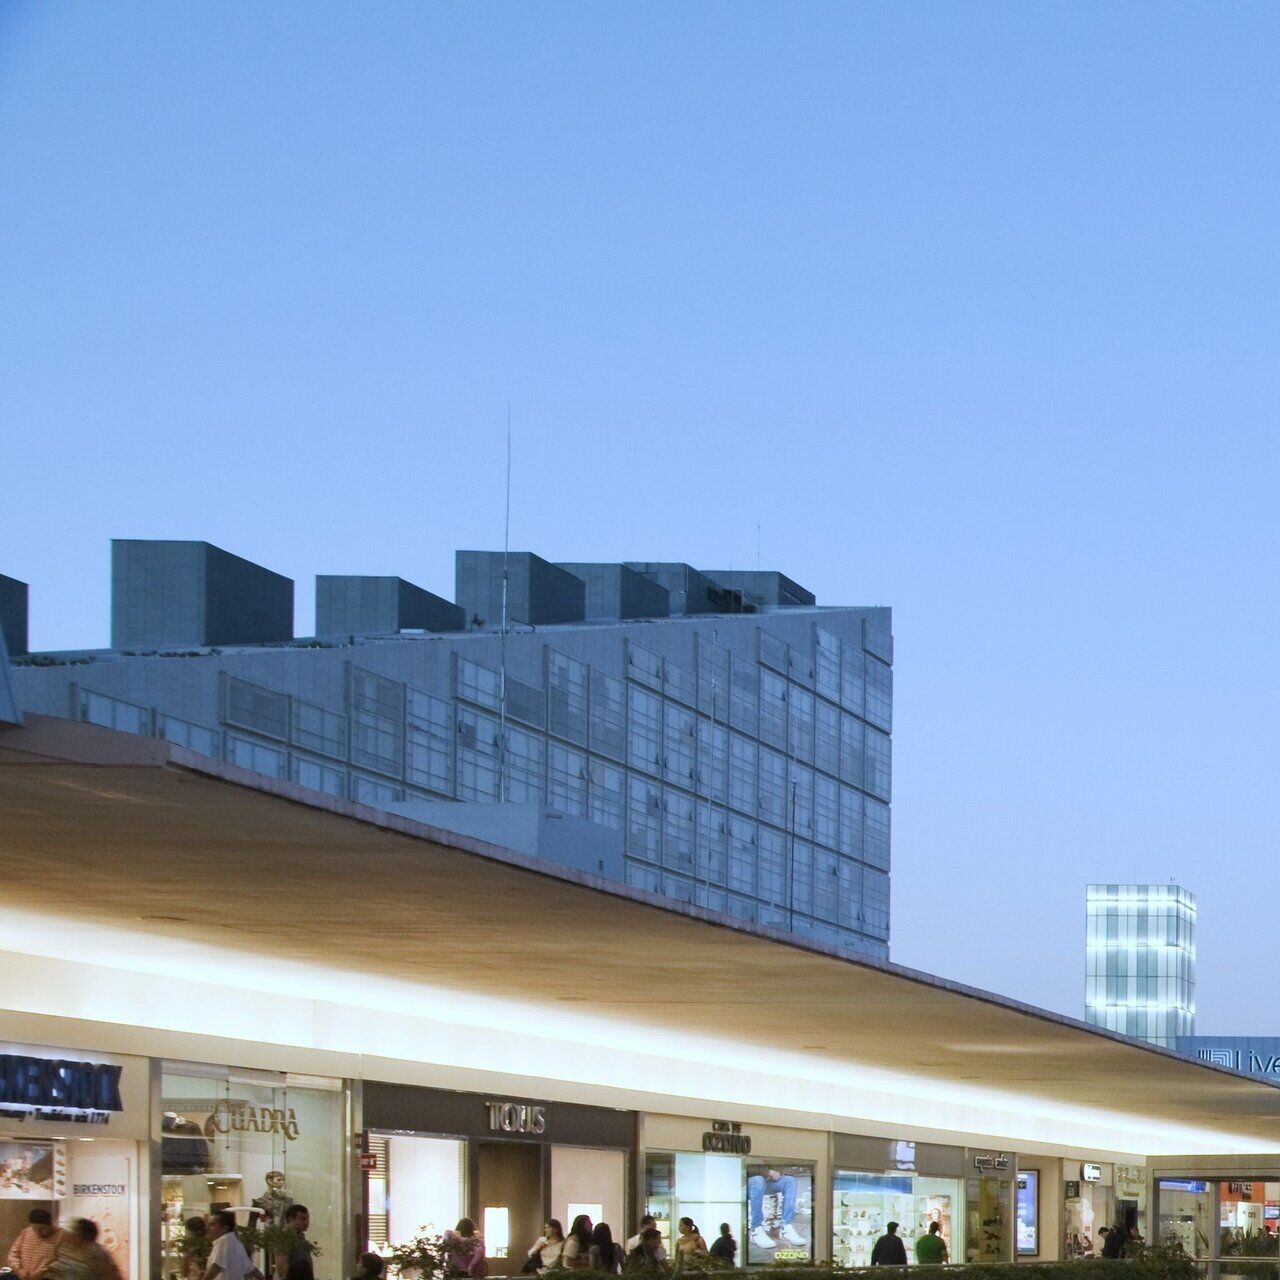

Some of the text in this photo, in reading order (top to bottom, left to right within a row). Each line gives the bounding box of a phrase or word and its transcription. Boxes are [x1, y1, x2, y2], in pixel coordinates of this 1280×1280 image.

[213, 1098, 300, 1141] CUADRA
[485, 1102, 545, 1133] TOUS
[702, 1131, 751, 1155] OZONO
[774, 1251, 809, 1260] OZONO
